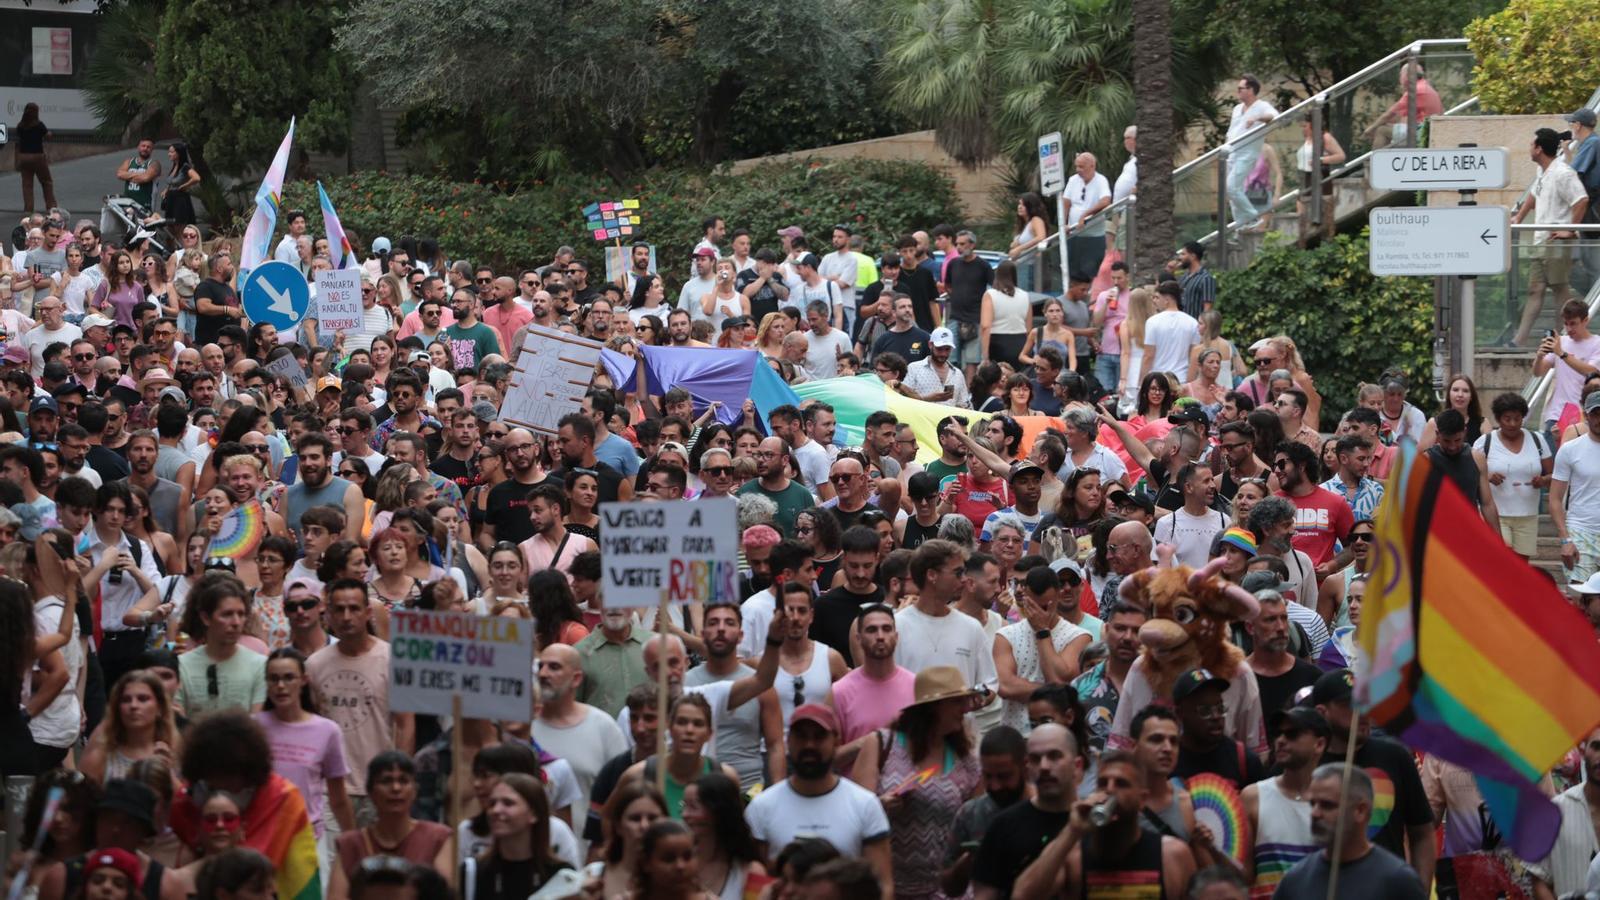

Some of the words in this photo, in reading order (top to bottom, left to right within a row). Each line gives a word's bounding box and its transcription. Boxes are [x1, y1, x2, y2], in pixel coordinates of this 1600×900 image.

[1391, 157, 1407, 171] C/
[1412, 156, 1427, 171] DE
[1432, 156, 1448, 171] LA
[1453, 155, 1487, 170] RIERA
[1376, 212, 1430, 227] bulthaup
[327, 271, 336, 279] MI
[320, 280, 354, 289] PANCARTA
[327, 291, 340, 300] NO
[341, 290, 350, 300] ES
[524, 357, 570, 380] LIBRE
[603, 508, 666, 529] VENGO
[688, 508, 703, 528] A
[603, 534, 670, 556] MARCHAR
[681, 535, 715, 555] PARA
[609, 566, 662, 588] VERTE
[668, 556, 736, 602] RABIAR
[393, 667, 413, 687] NO
[419, 668, 457, 691] ERES
[461, 673, 482, 693] MI
[490, 676, 524, 698] TIPO
